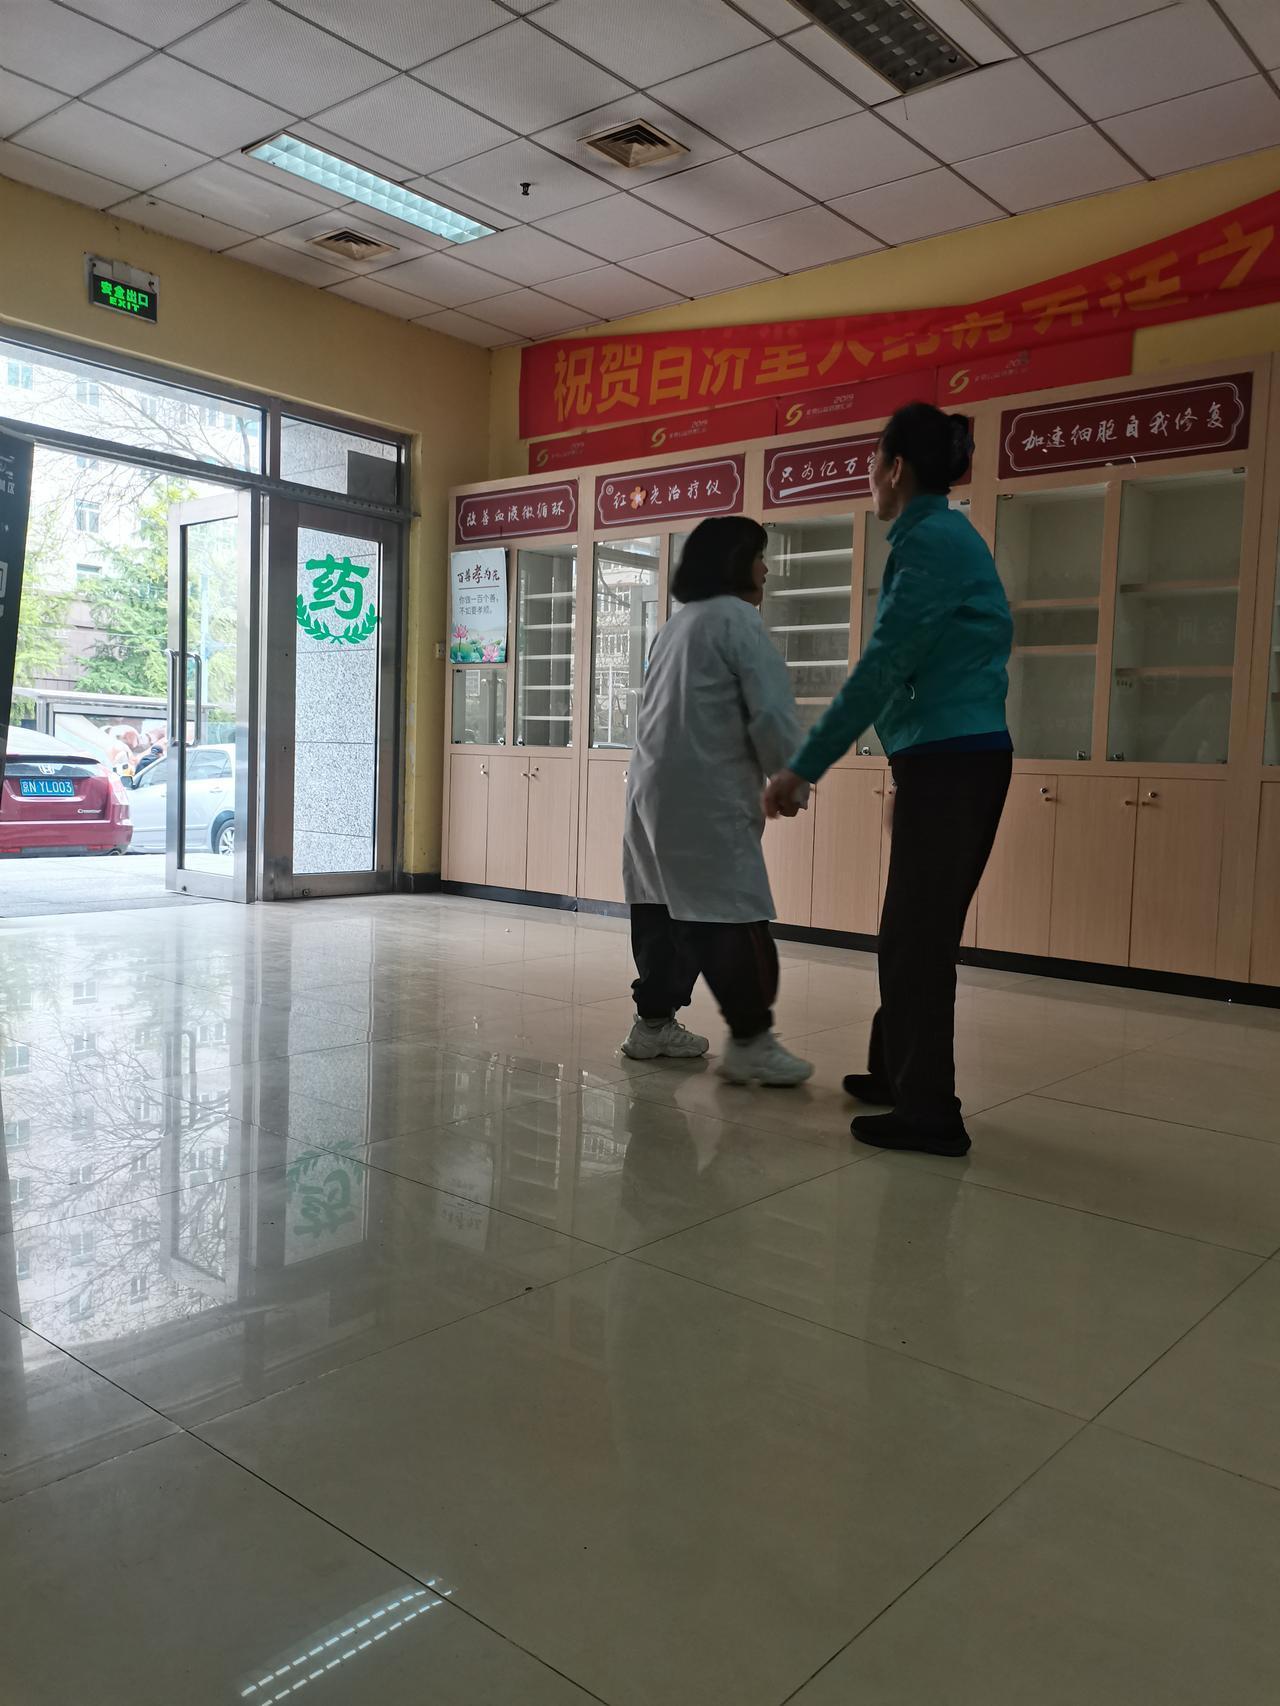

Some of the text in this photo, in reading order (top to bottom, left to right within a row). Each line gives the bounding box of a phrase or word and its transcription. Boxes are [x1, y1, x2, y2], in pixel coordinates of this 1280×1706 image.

[100, 280, 149, 308] 安全出口
[109, 296, 140, 312] EXIT
[1021, 401, 1225, 452] 加速细胞自我修复
[613, 479, 722, 510] 红光治疗仪
[466, 500, 565, 527] 改善血液微循环
[305, 553, 370, 620] 药
